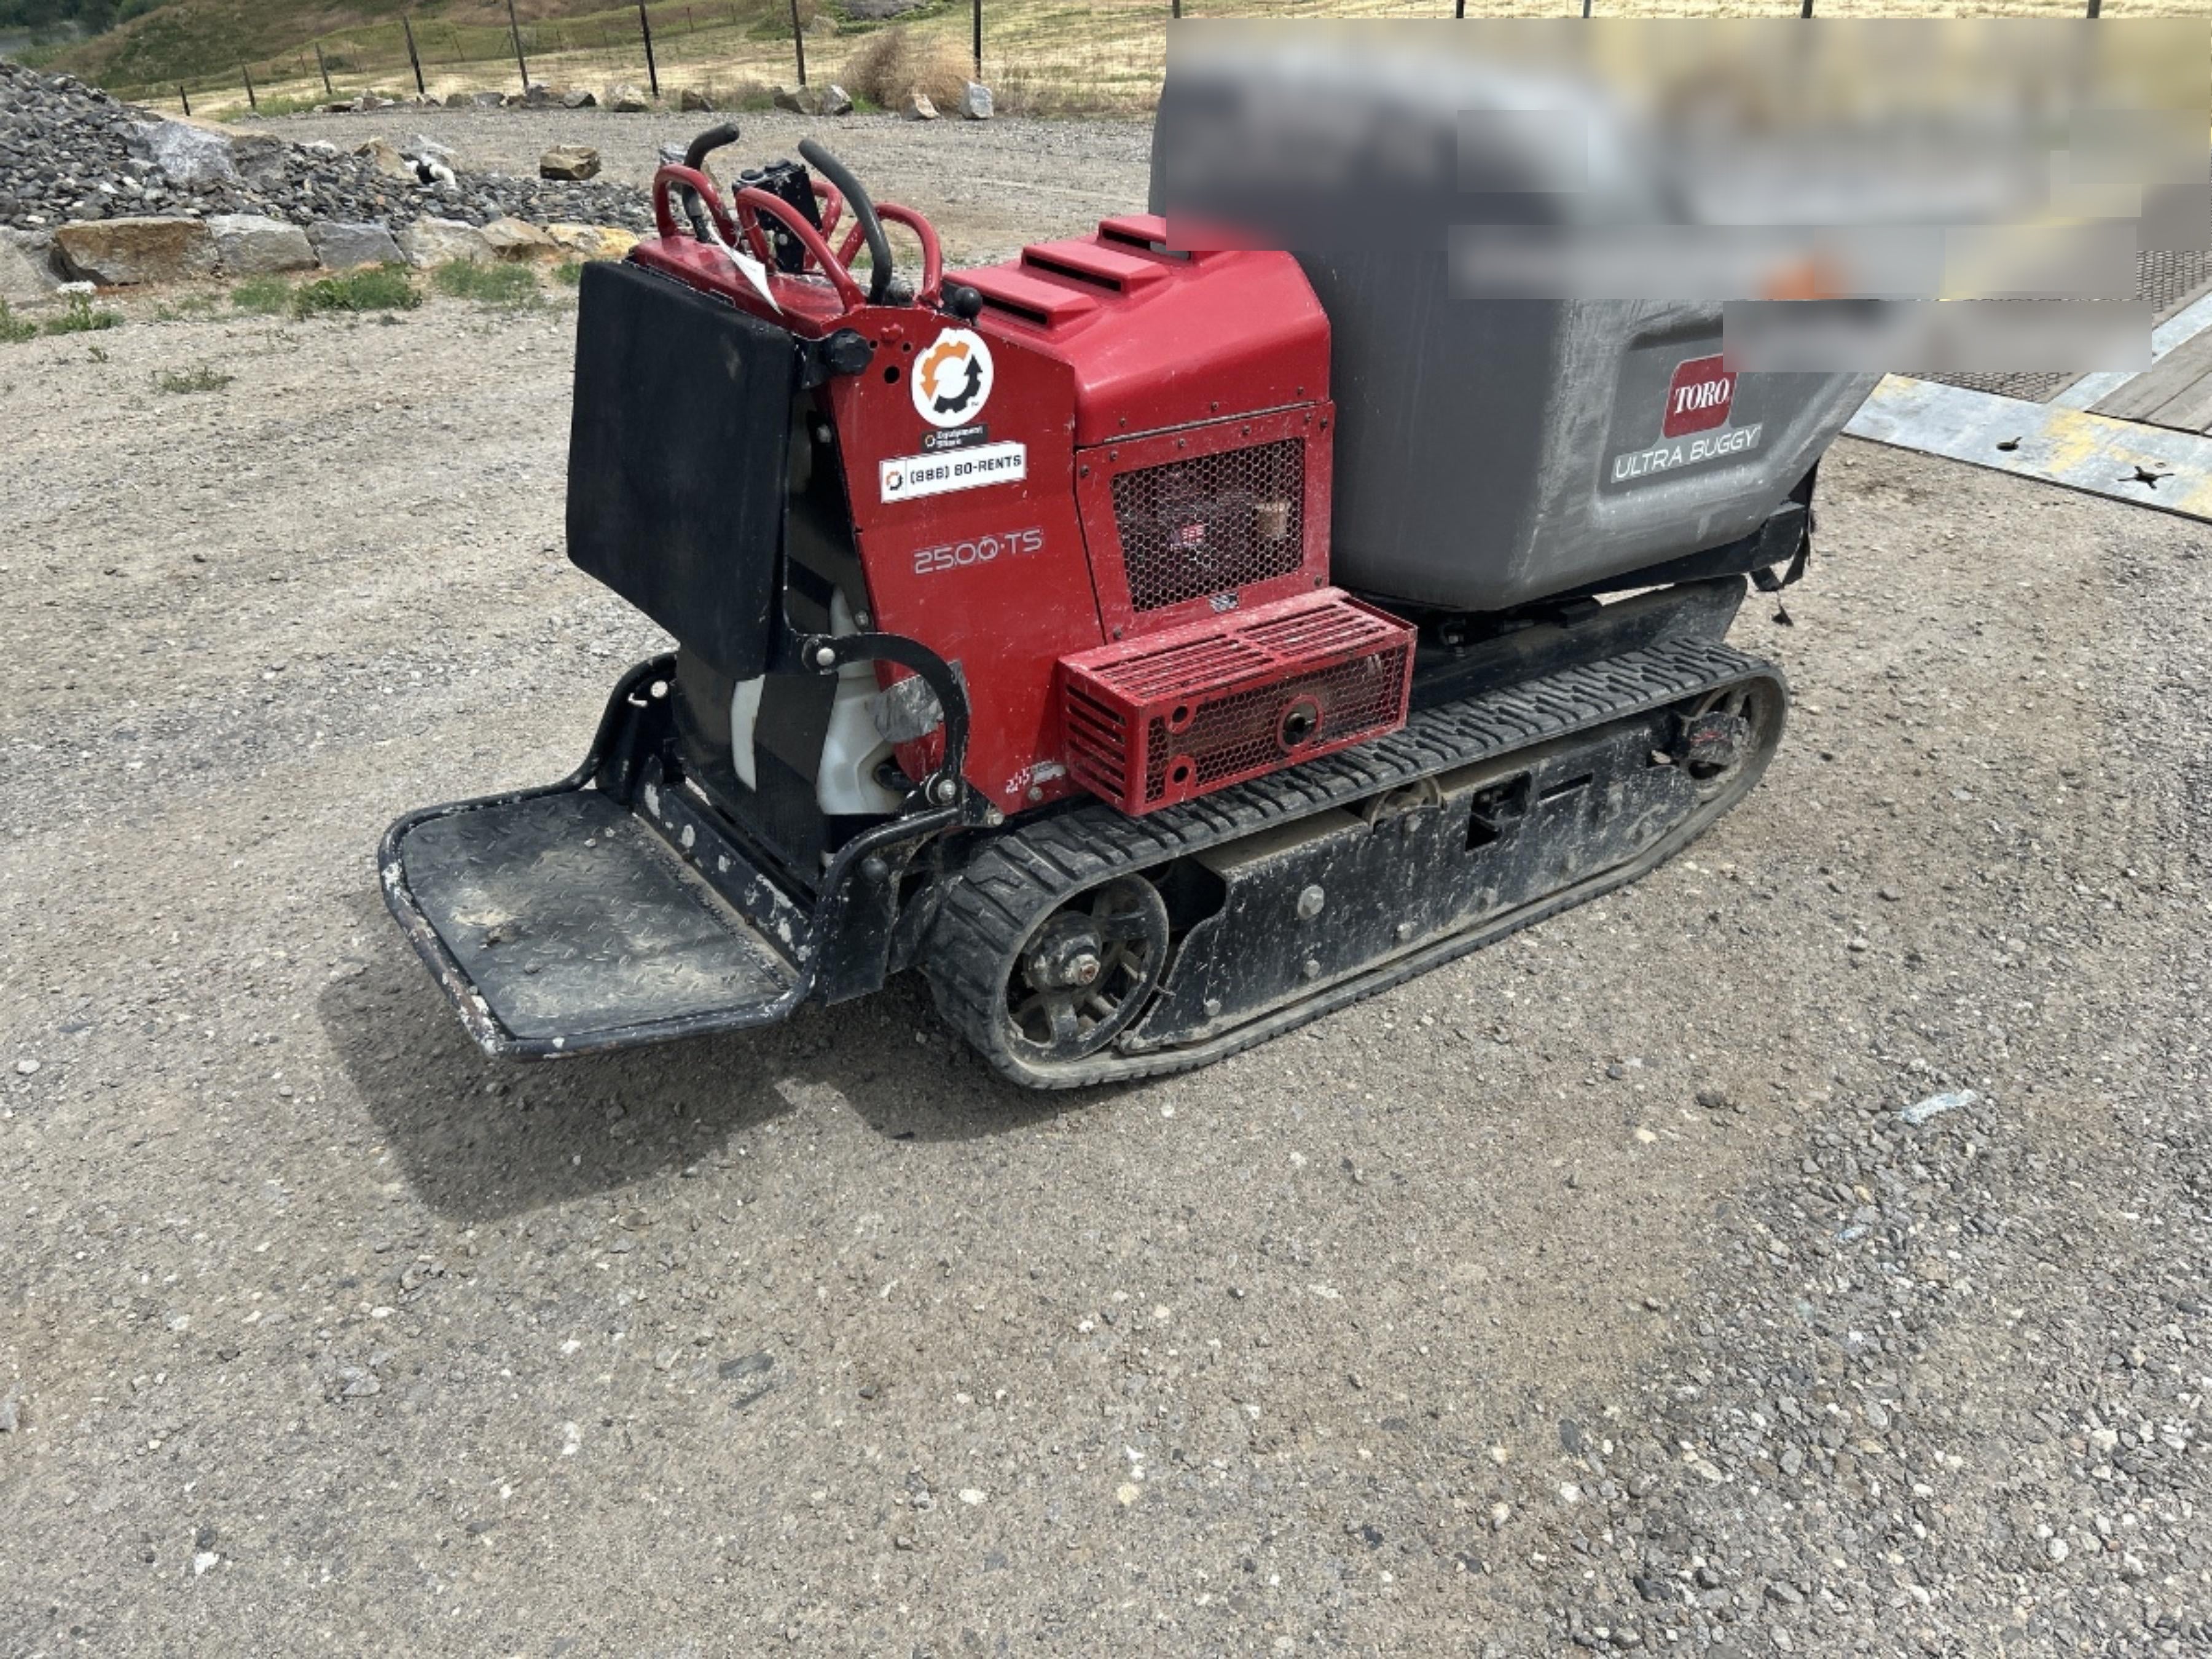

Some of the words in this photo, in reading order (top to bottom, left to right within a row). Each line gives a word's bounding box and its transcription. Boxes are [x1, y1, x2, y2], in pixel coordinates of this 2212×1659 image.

[1674, 378, 1730, 414] TORO
[1615, 445, 1683, 478] ULTRA
[1690, 428, 1759, 461] BUGGY
[910, 465, 950, 485] (888)
